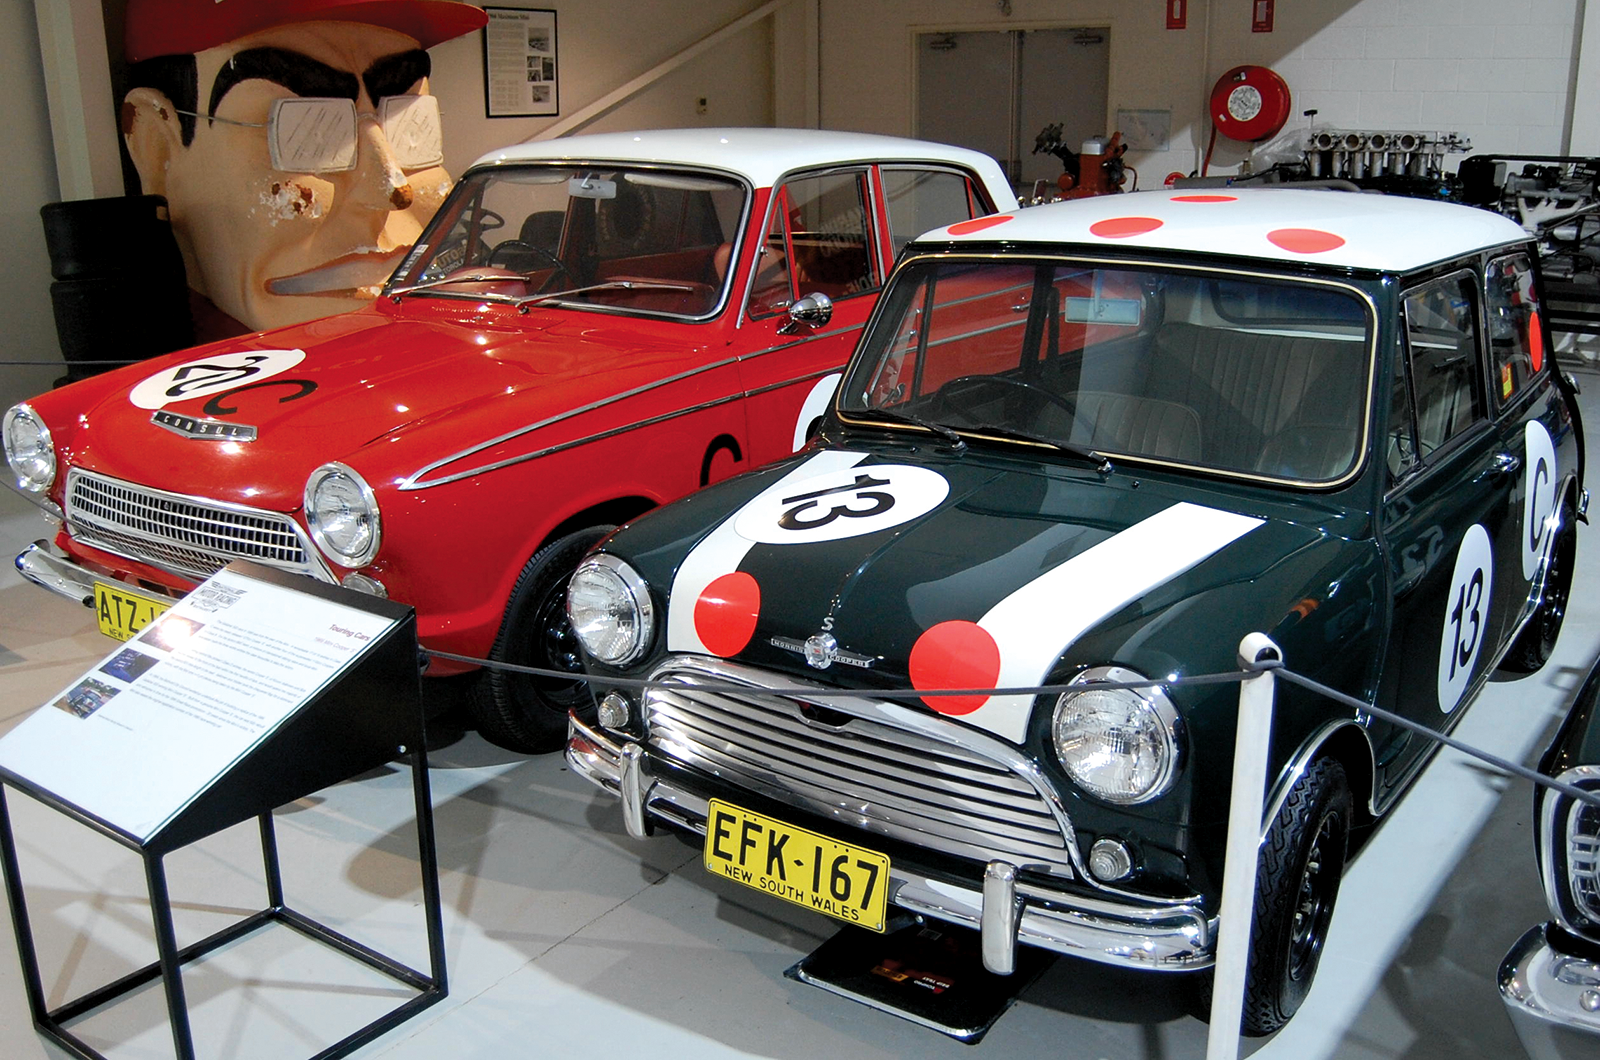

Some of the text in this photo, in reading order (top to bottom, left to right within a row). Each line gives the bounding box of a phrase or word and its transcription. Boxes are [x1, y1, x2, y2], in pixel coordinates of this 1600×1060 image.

[165, 356, 269, 396] 20
[203, 379, 318, 415] C
[164, 415, 237, 436] CONSUL
[777, 474, 896, 531] 13
[1530, 457, 1549, 553] C
[329, 623, 371, 642] Touring Cars
[821, 616, 834, 631] S
[1449, 567, 1483, 682] 13
[725, 864, 859, 920] NEW SOUTH WALES
